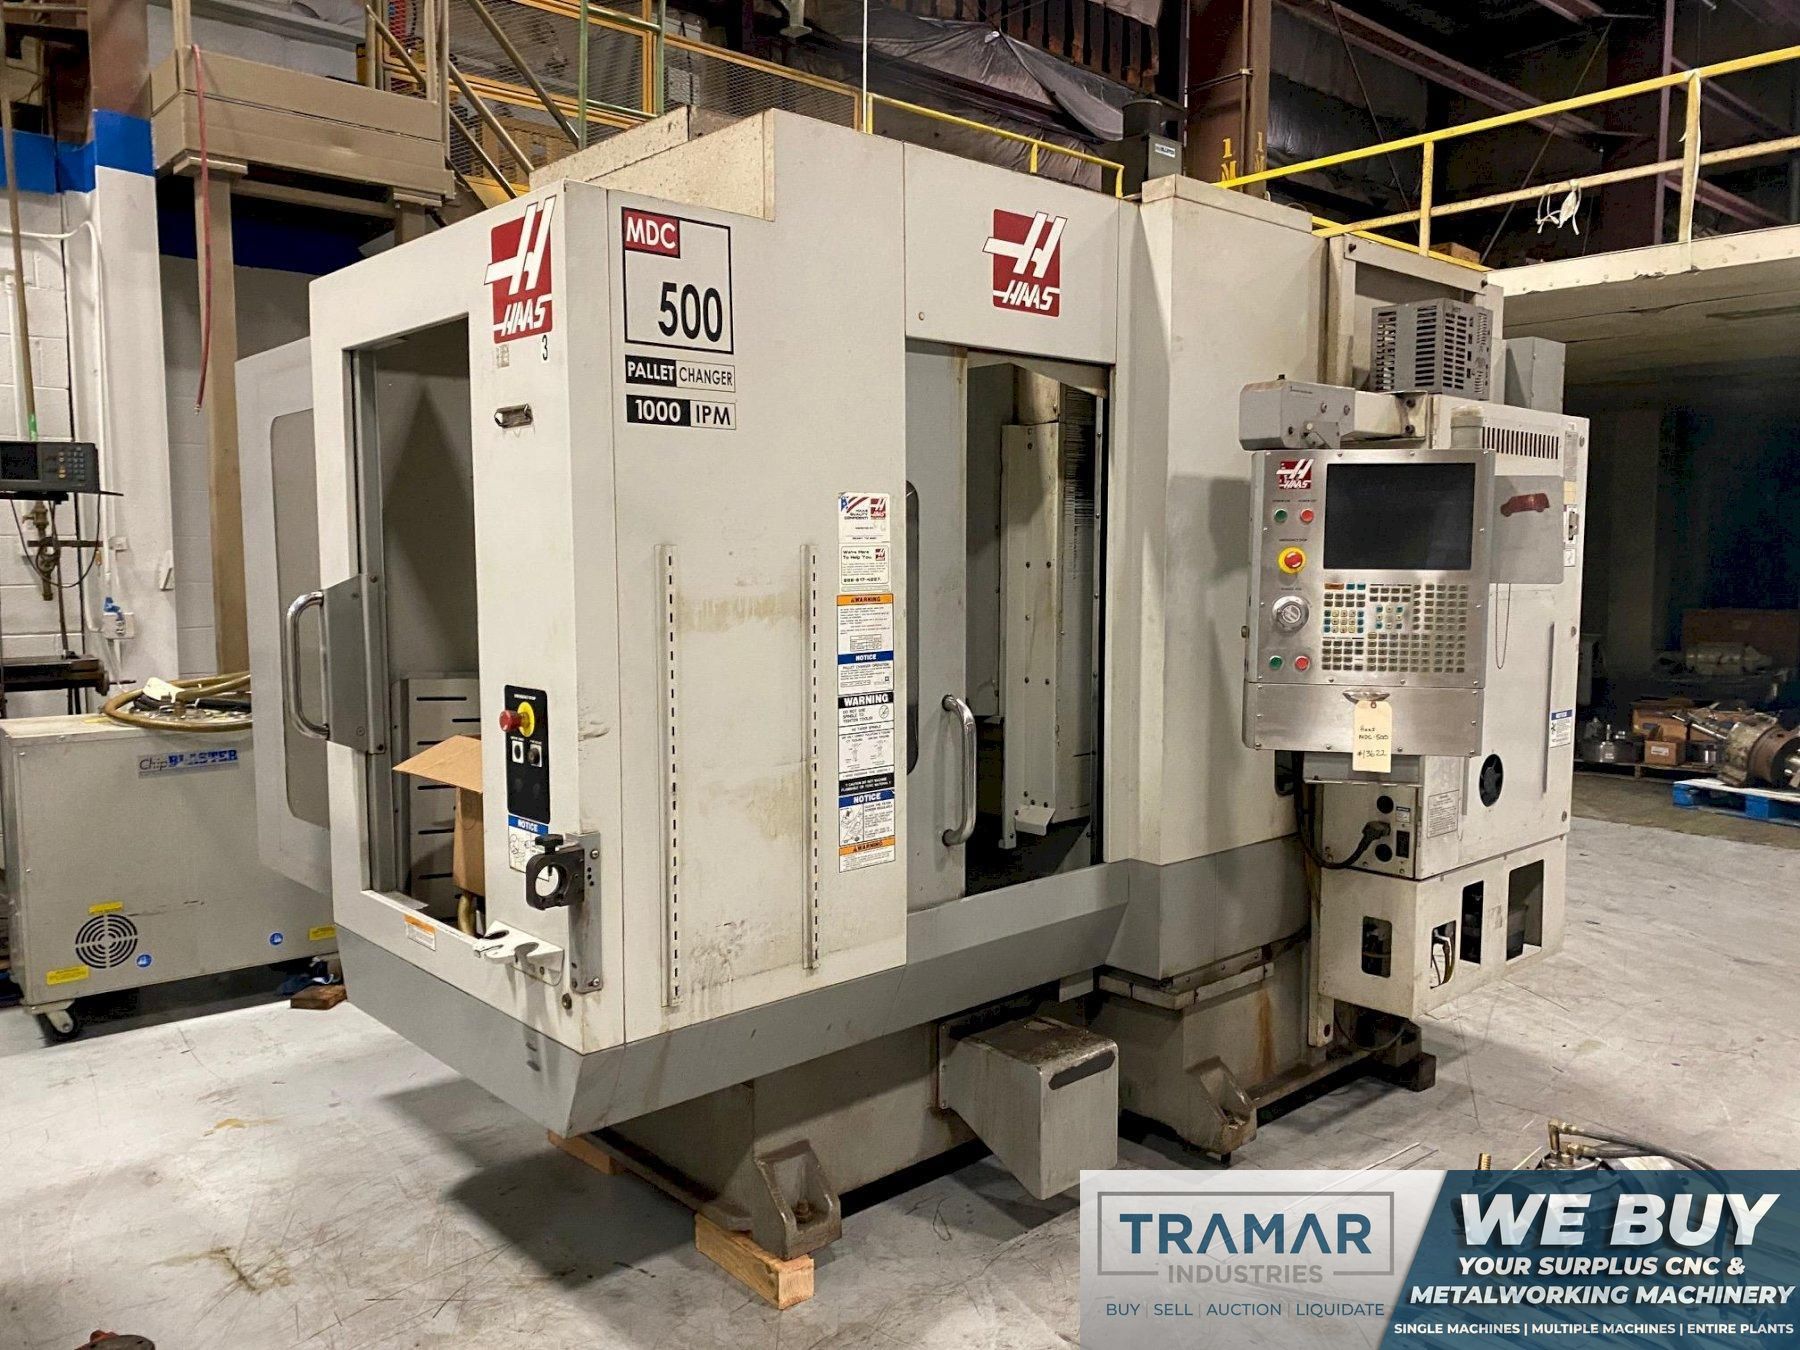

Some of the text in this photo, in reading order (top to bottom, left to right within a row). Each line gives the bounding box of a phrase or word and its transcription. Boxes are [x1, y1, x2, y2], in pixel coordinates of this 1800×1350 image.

[626, 216, 676, 249] MDC
[992, 279, 1060, 311] HAAS
[493, 292, 552, 337] HAAS
[658, 281, 723, 342] 500
[541, 334, 548, 361] 3
[627, 361, 733, 386] PALLET CHANGER
[635, 399, 731, 426] 1000 IPM
[1279, 480, 1312, 489] HAAS
[855, 653, 877, 661] NOTICE
[843, 693, 889, 707] WARNING
[853, 792, 881, 804] NOTICE
[517, 819, 538, 832] NOTICE
[857, 840, 883, 850] WARNING
